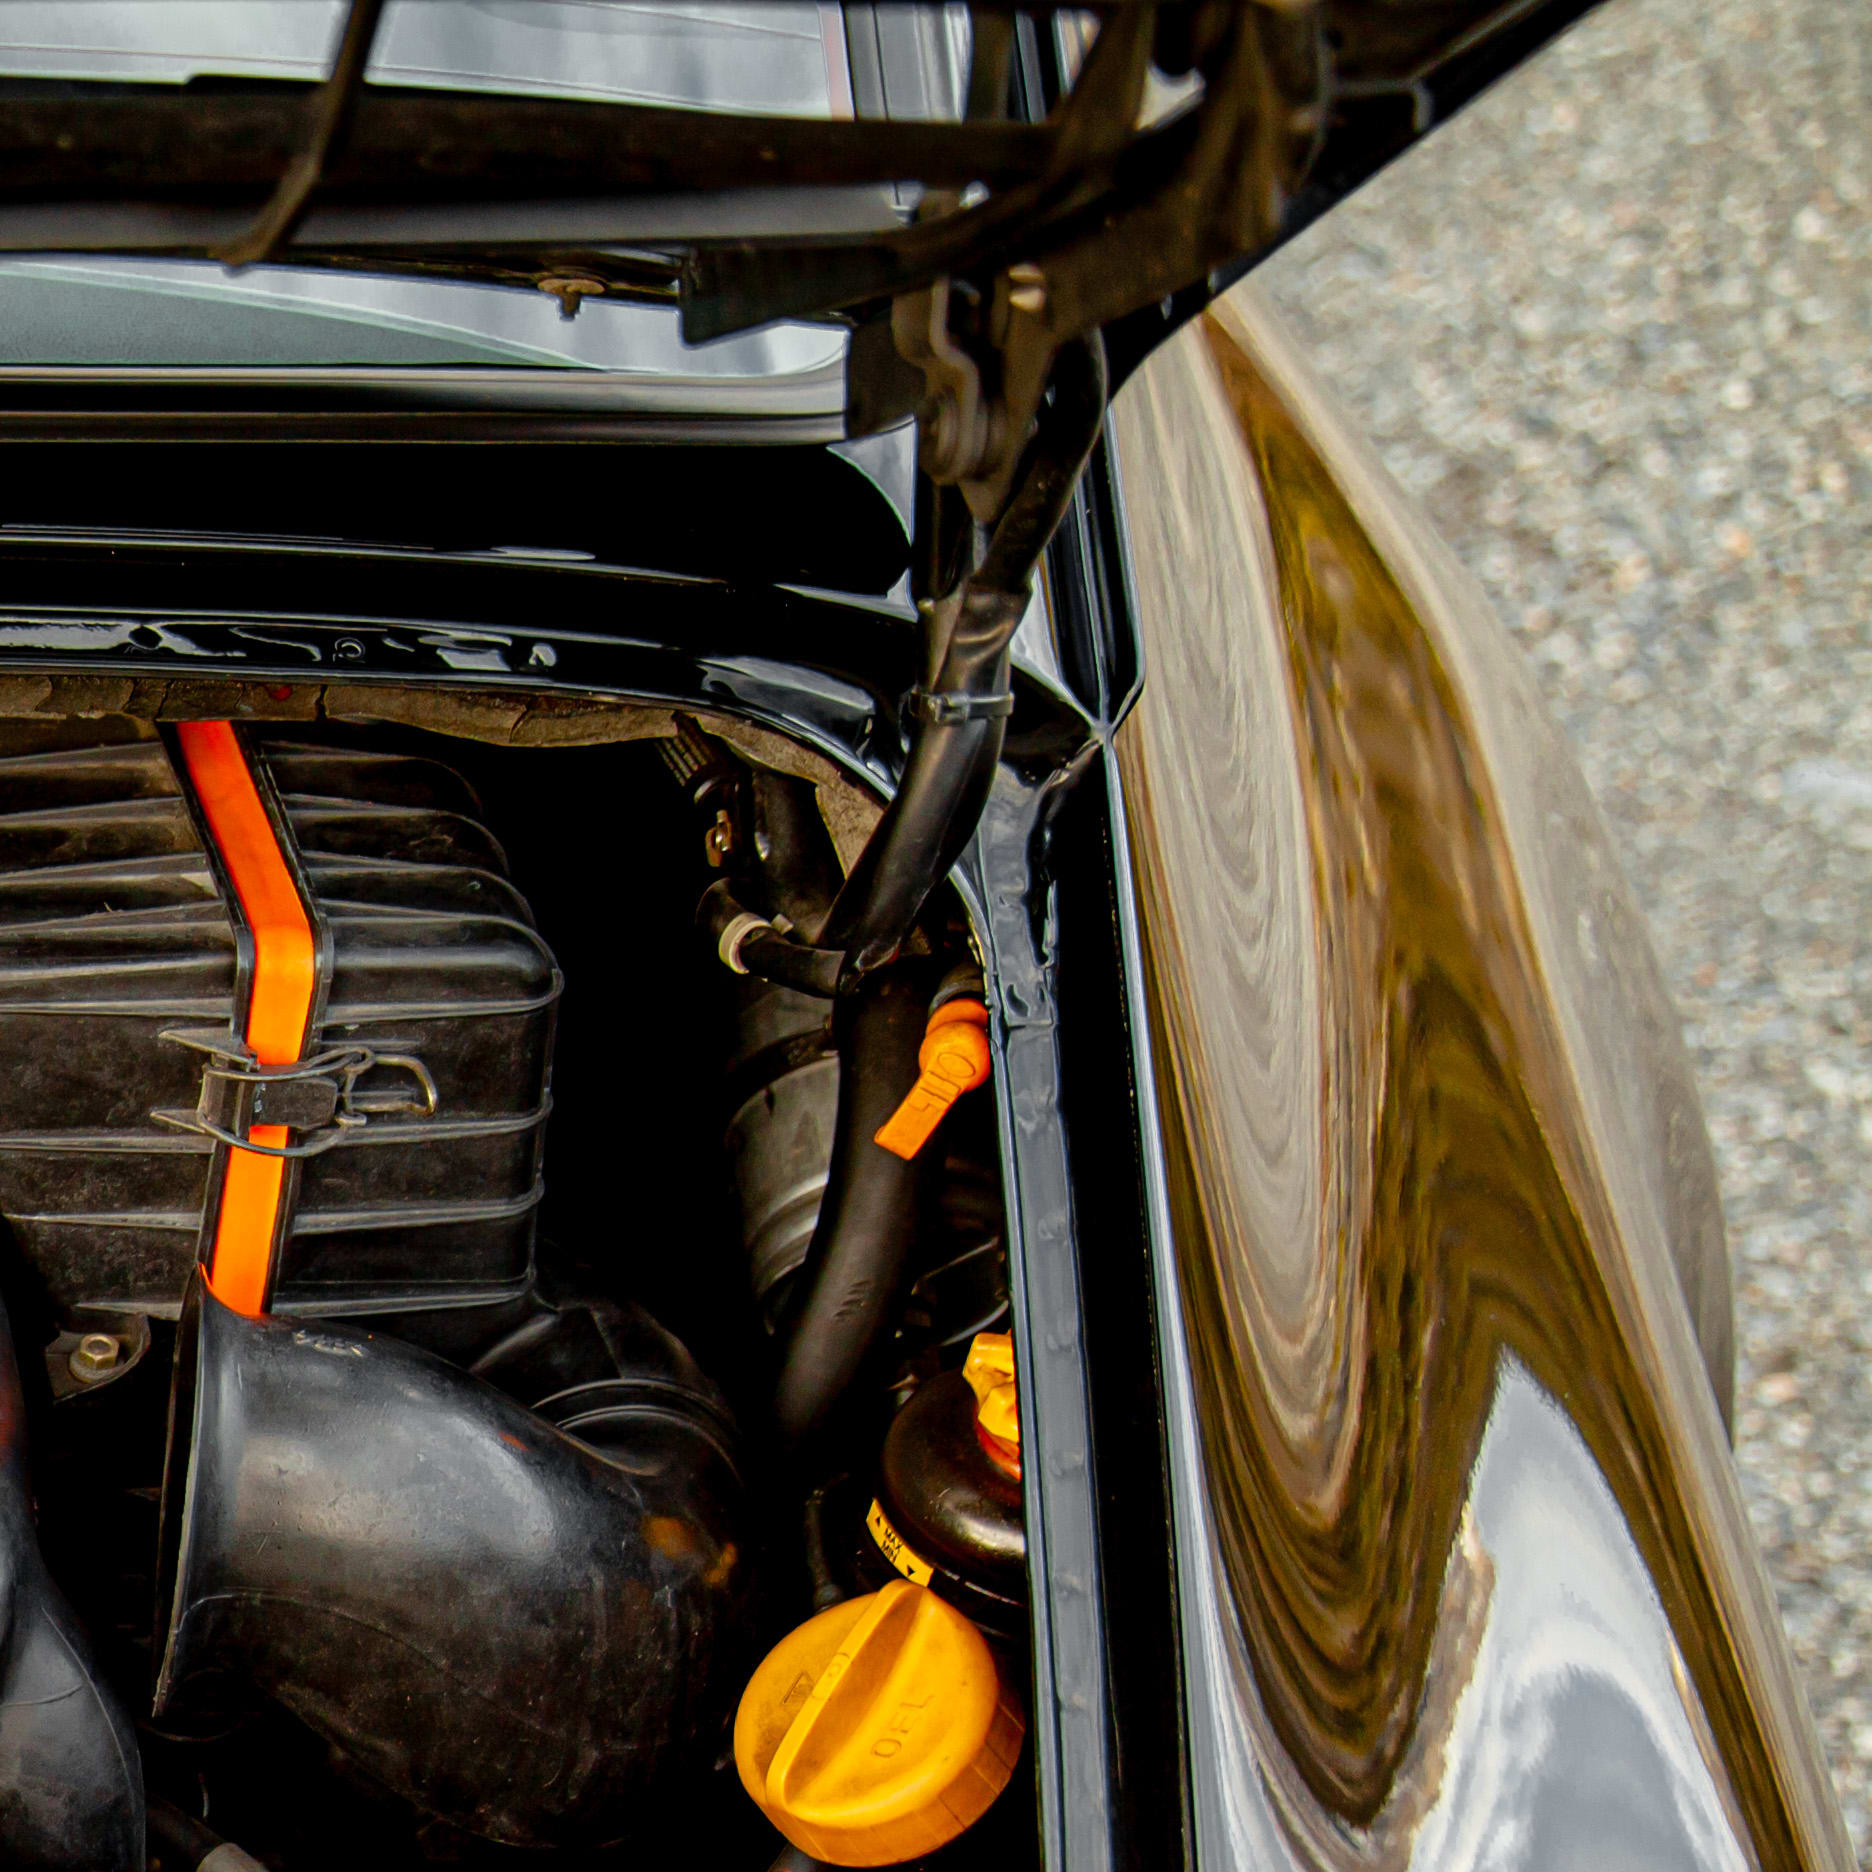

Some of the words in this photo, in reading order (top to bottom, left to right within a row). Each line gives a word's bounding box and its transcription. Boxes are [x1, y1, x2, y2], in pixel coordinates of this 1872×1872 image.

[884, 1527, 905, 1551] MAX
[881, 1540, 900, 1563] MIN
[870, 1694, 936, 1758] OEL
